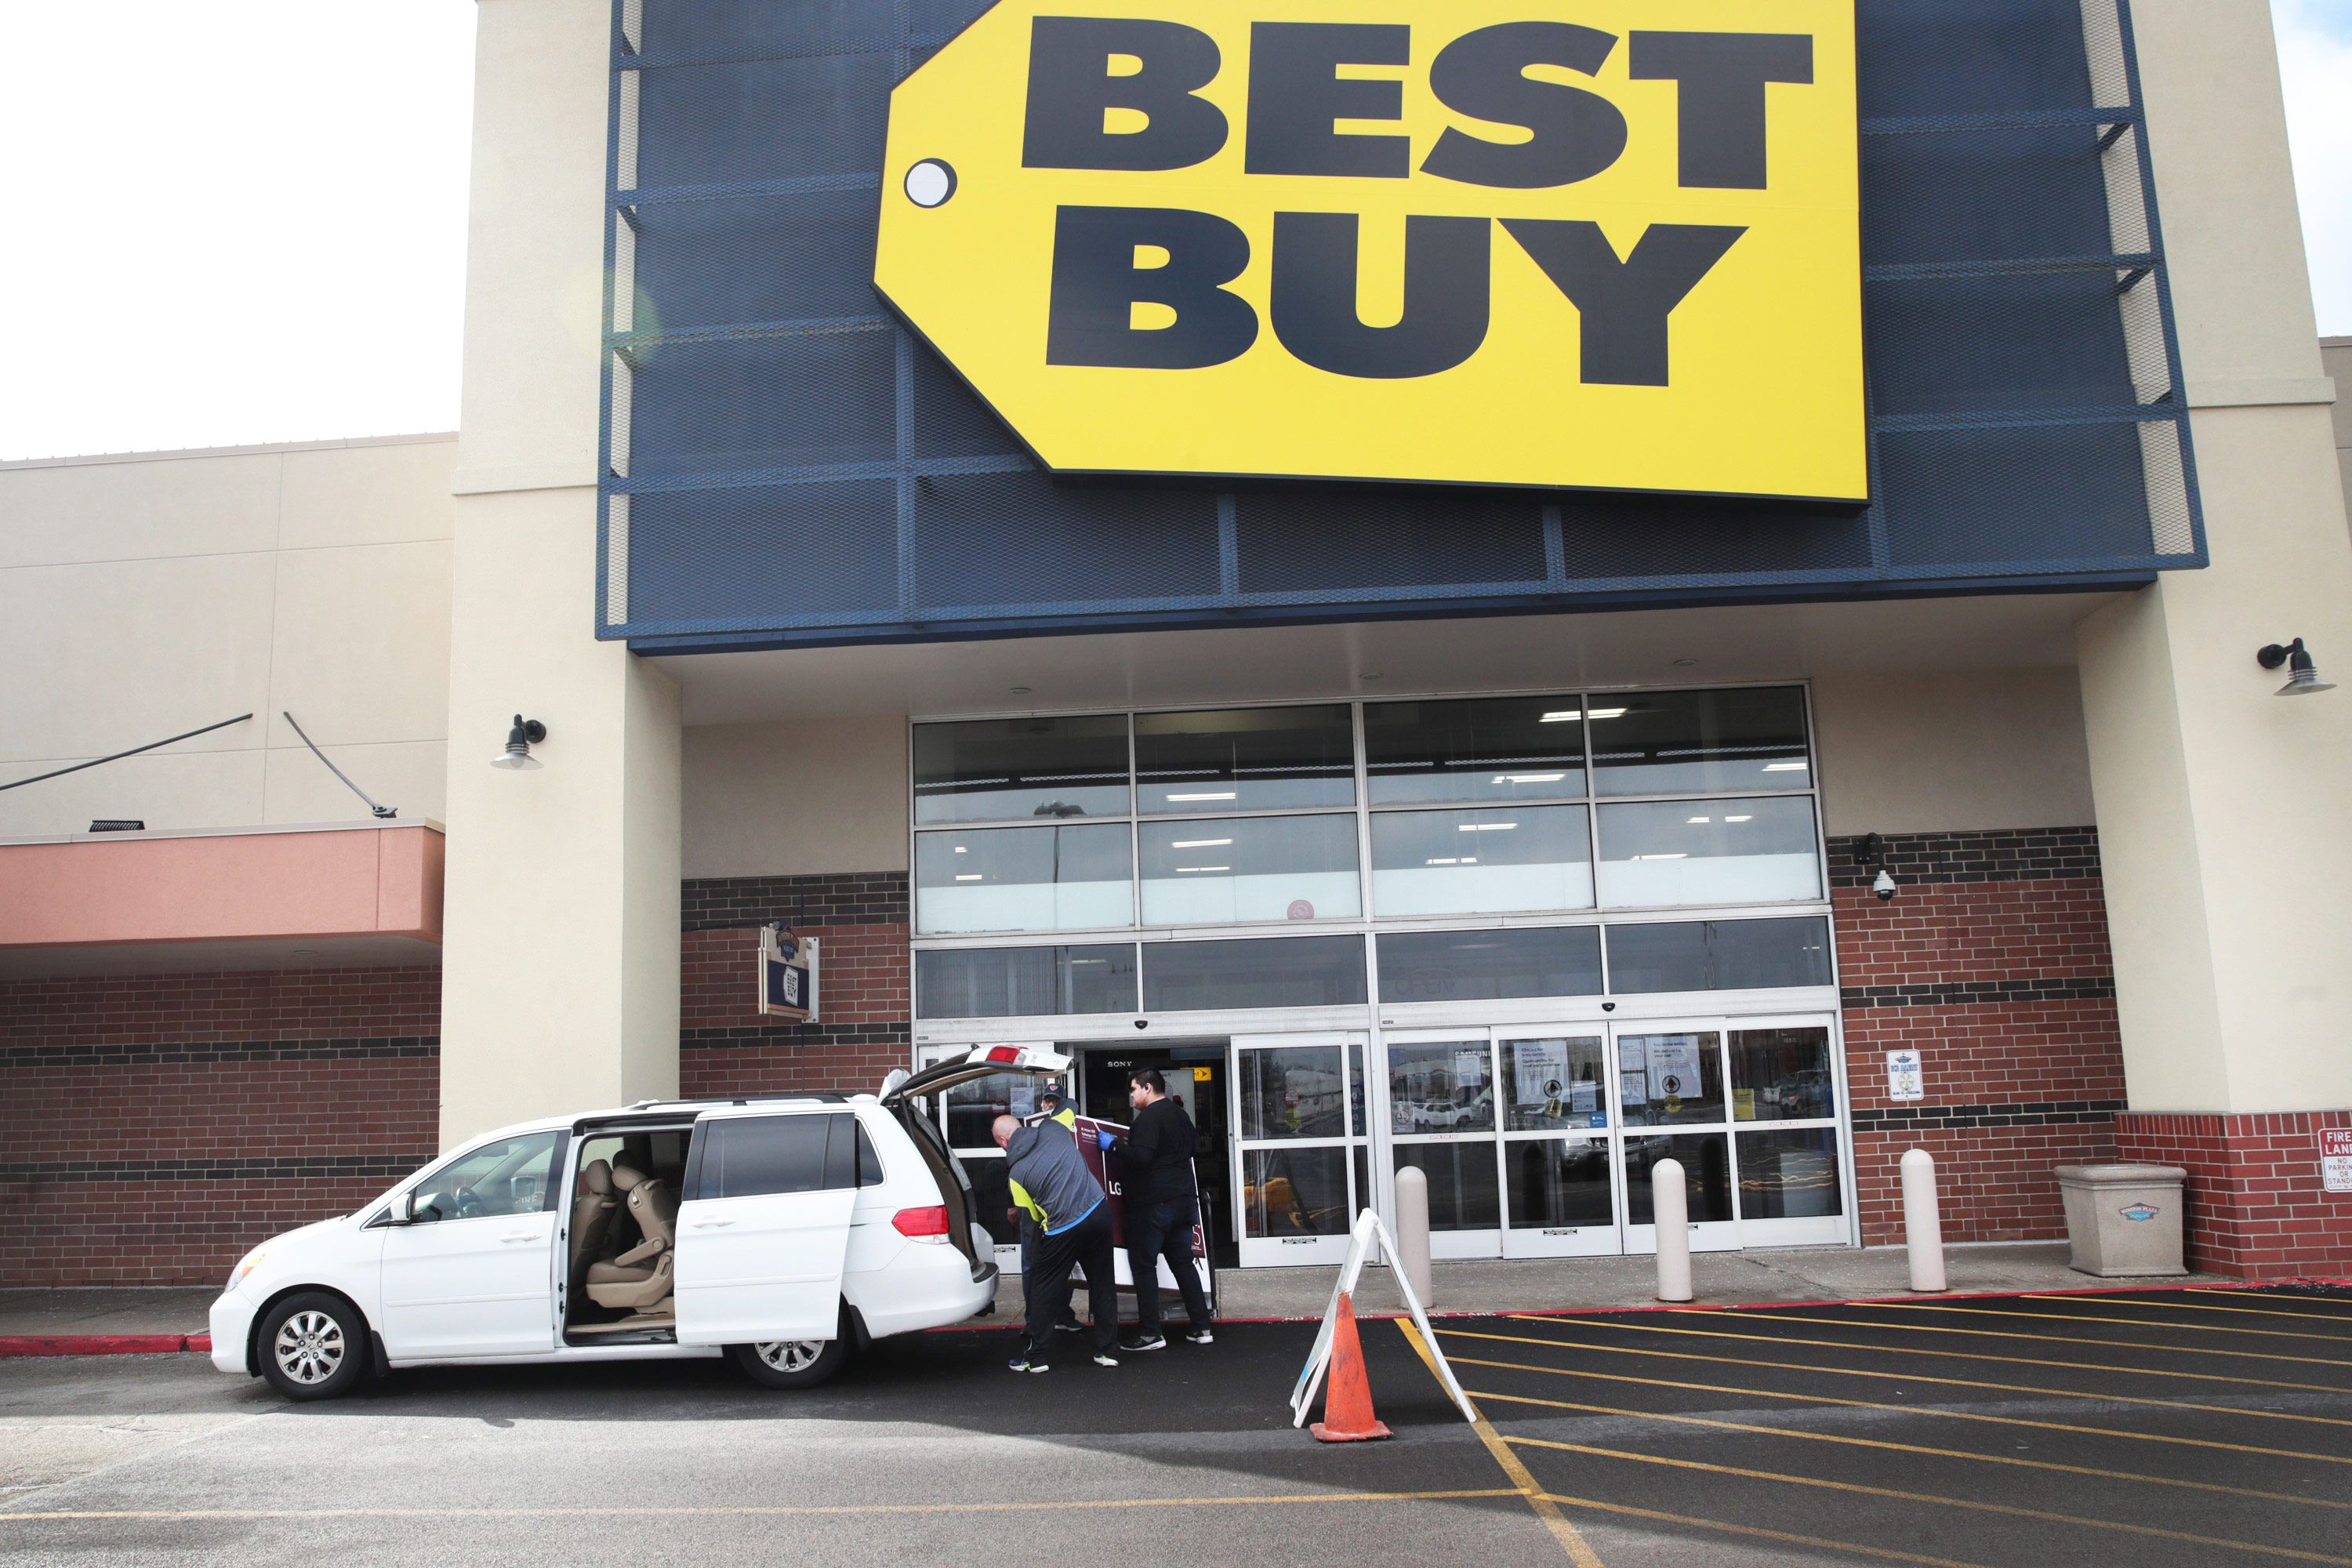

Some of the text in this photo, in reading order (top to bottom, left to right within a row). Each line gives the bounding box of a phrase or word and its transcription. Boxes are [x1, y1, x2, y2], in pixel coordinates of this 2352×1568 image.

[1021, 15, 1813, 190] BEST
[1046, 204, 1750, 387] BUY
[2326, 1131, 2352, 1142] FIRE
[1109, 1180, 1122, 1196] LG
